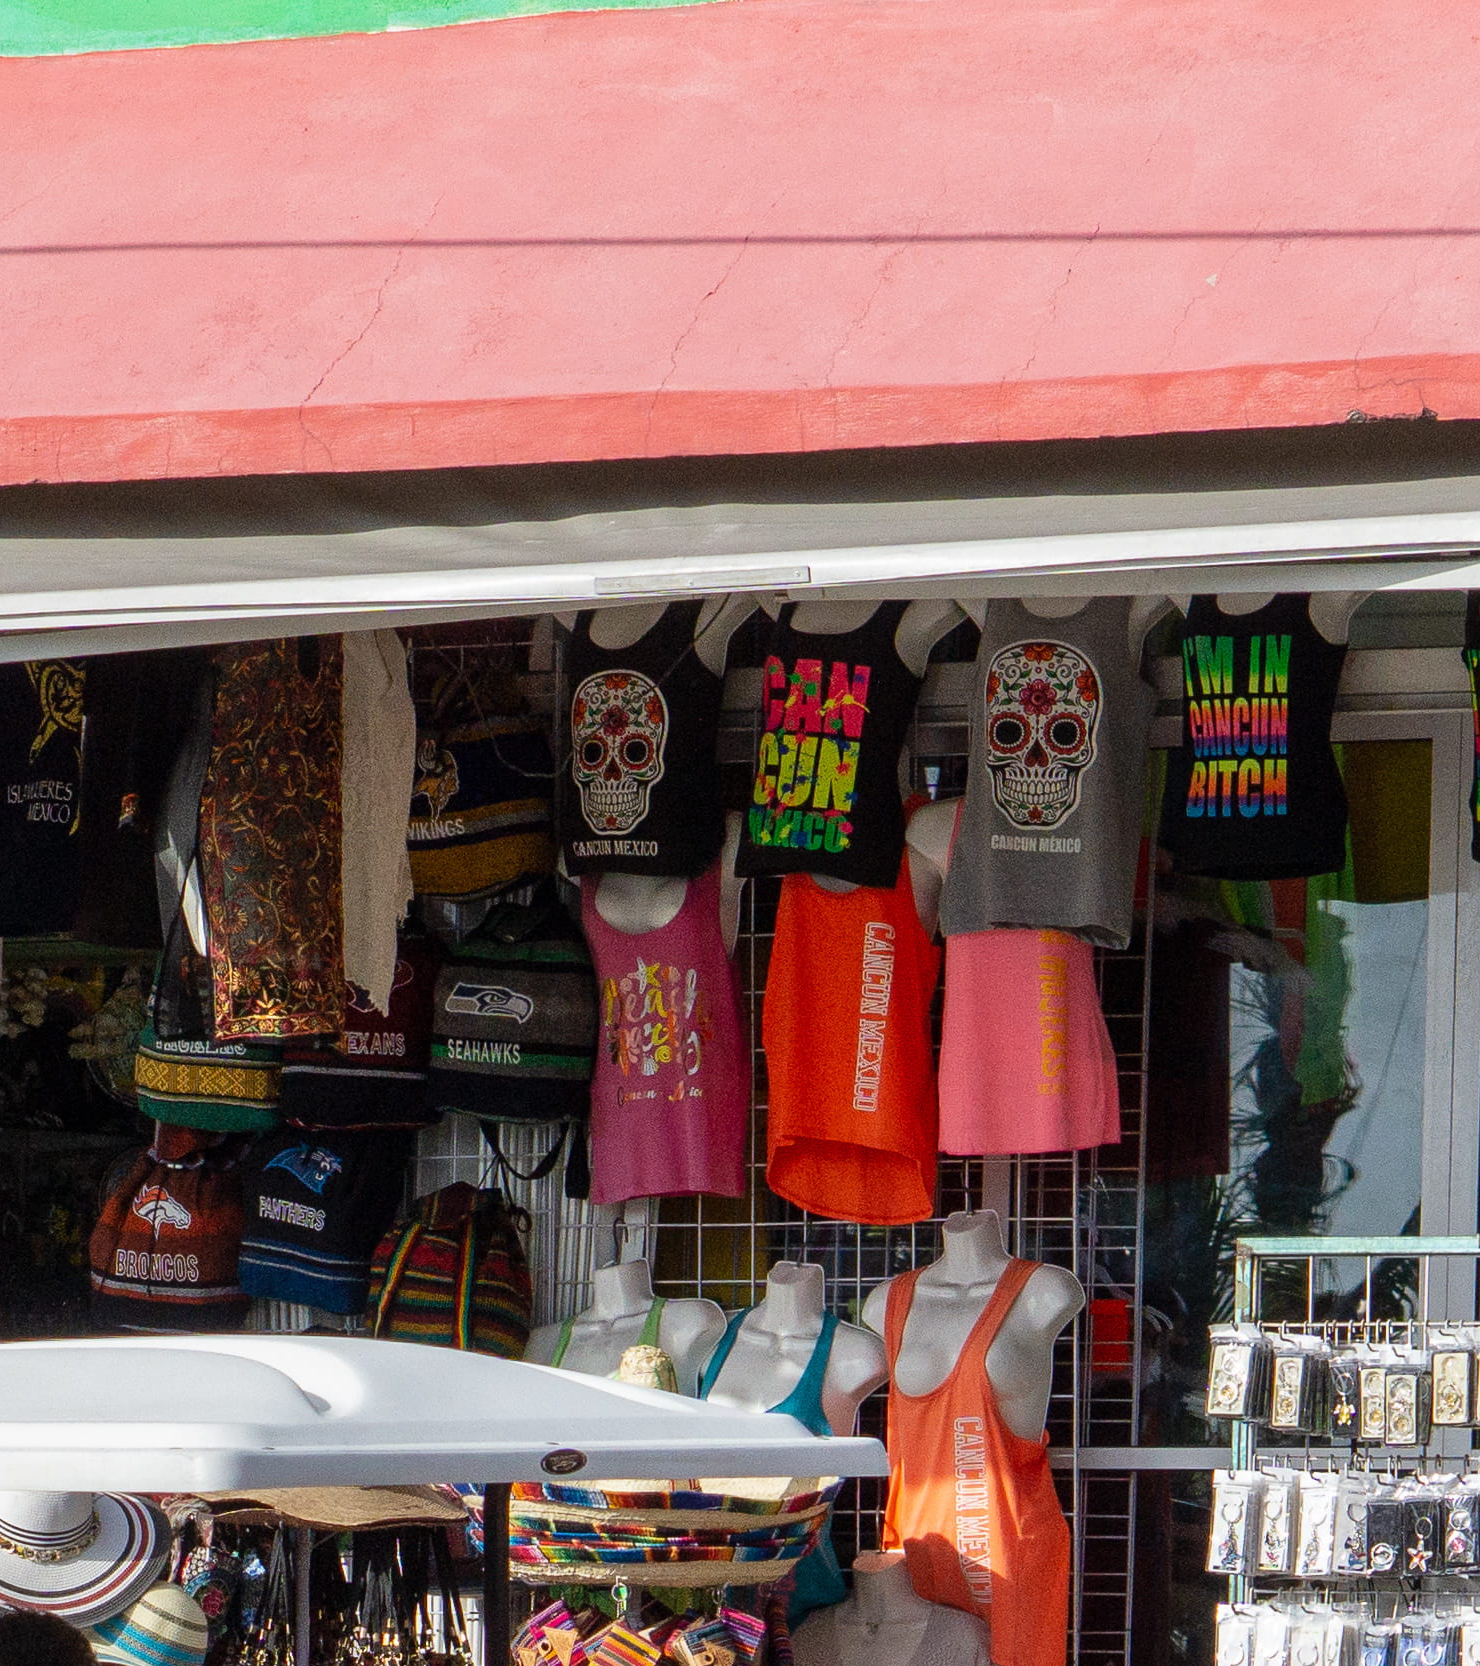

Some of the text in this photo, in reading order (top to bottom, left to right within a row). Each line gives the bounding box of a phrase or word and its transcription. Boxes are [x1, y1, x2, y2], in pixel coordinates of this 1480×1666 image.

[1183, 634, 1292, 697] I'M IN
[762, 655, 872, 738] CAN
[1189, 697, 1289, 758] CANCUN
[753, 731, 861, 813] CUN
[1186, 757, 1288, 819] BITCH
[407, 818, 466, 842] VIKINGS
[572, 840, 659, 857] CANCUN MEXICO
[748, 806, 850, 854] MEXICO
[990, 834, 1037, 852] CANCUN
[852, 921, 896, 1113] CANCUN MEXICO
[446, 1037, 522, 1066] SEAHAWKS
[259, 1194, 327, 1233] PANTHERS
[115, 1248, 200, 1283] BRONCOS
[954, 1416, 989, 1513] CANCUN
